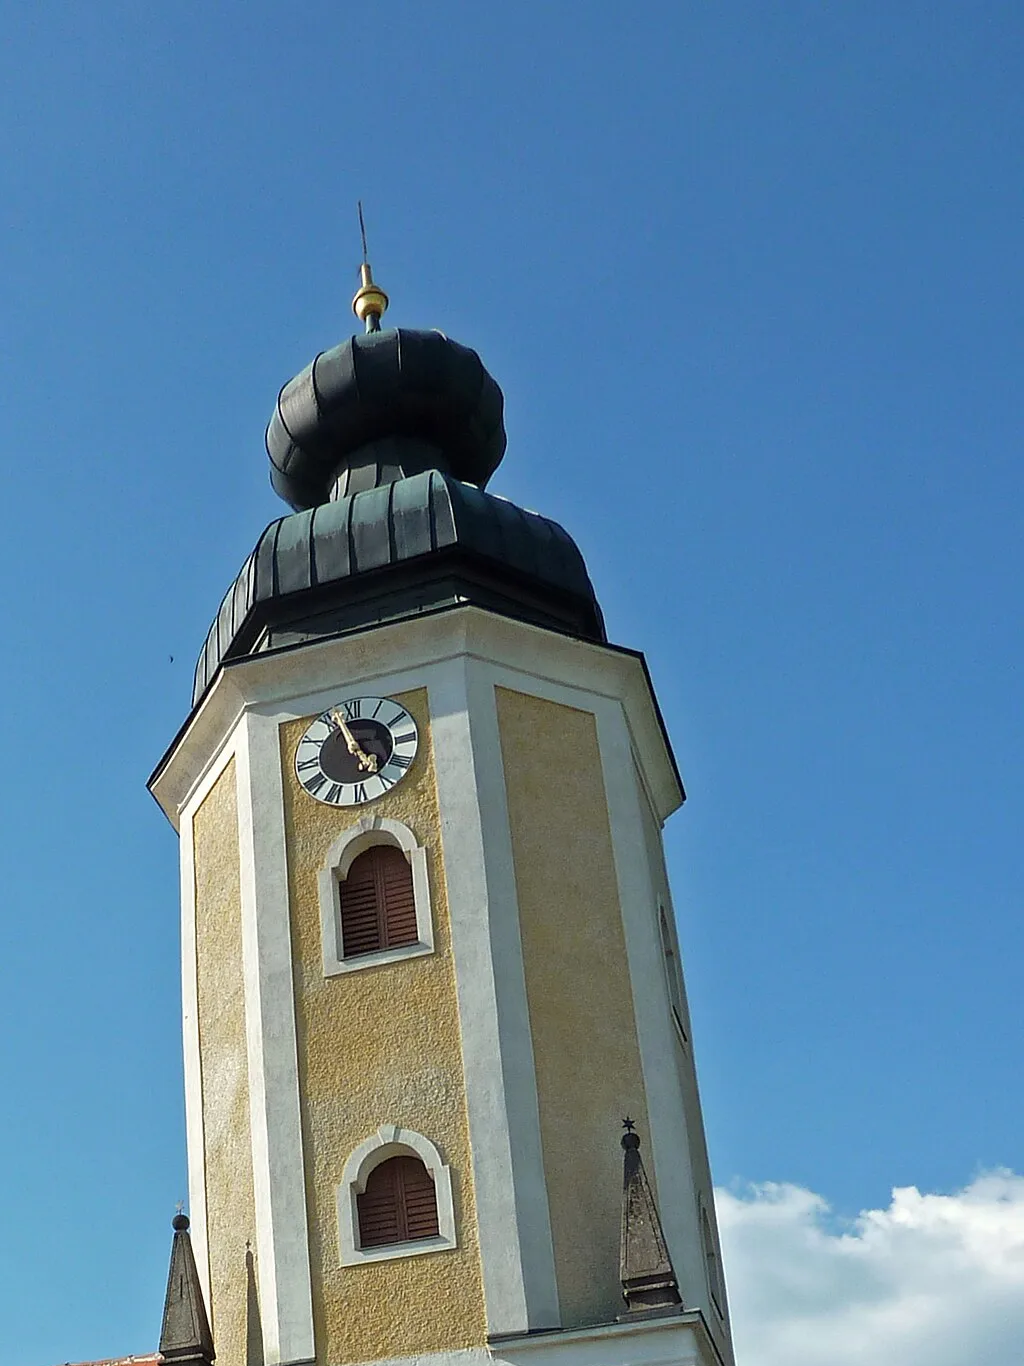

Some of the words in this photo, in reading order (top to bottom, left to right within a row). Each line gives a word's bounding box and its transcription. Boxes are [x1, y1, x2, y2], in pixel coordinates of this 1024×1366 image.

[344, 700, 361, 721] XII
[386, 711, 406, 728] II
[302, 735, 324, 747] X
[394, 731, 416, 745] III
[297, 756, 319, 772] IX
[378, 773, 394, 790] V
[324, 783, 343, 804] VII
[354, 782, 368, 803] VI
